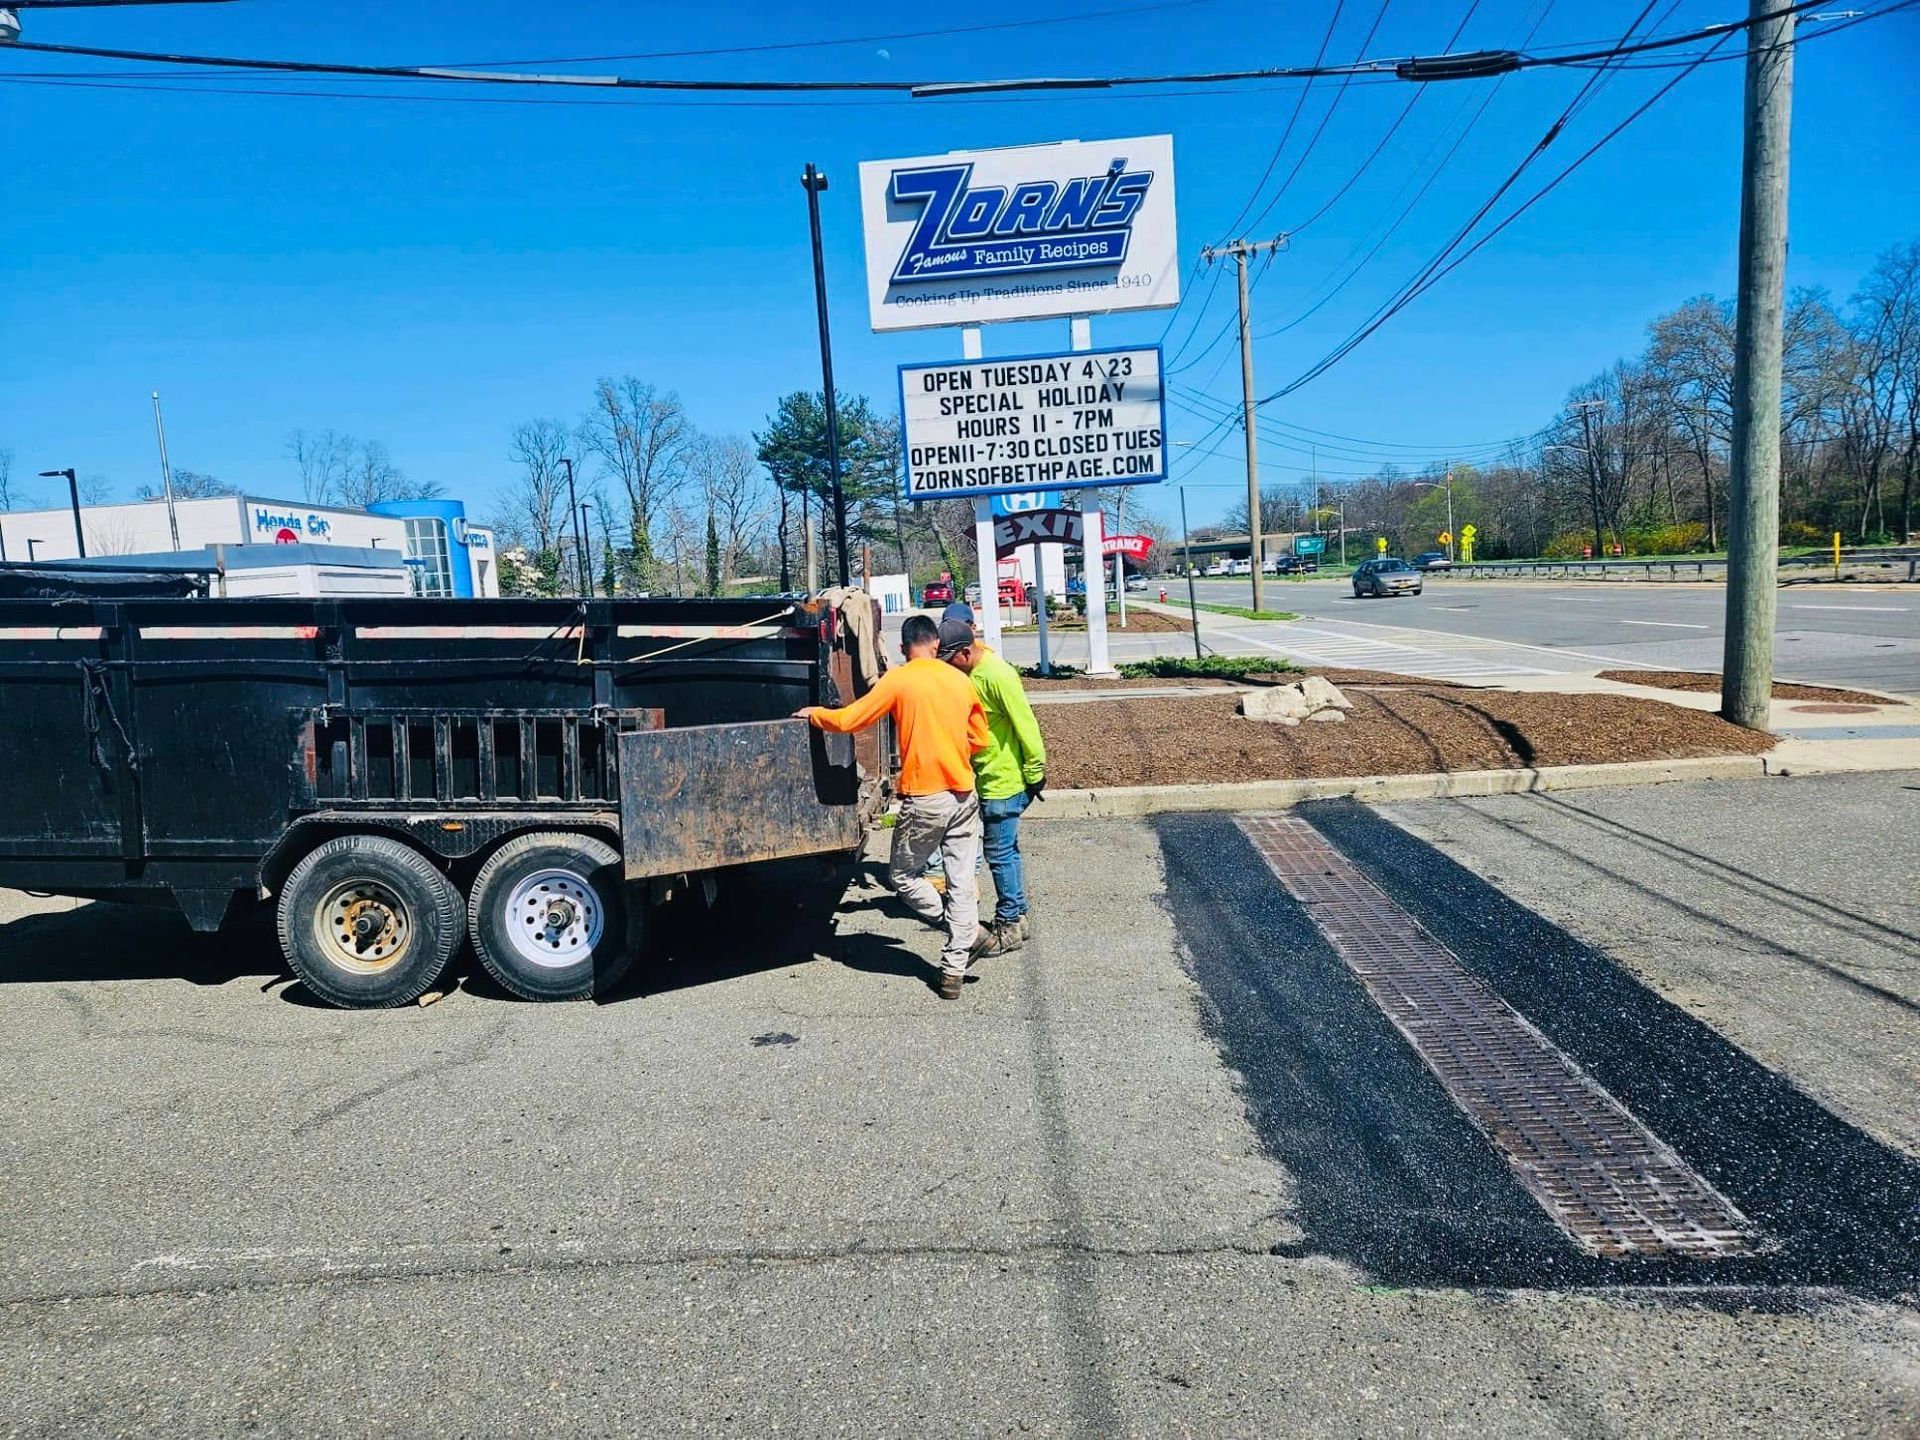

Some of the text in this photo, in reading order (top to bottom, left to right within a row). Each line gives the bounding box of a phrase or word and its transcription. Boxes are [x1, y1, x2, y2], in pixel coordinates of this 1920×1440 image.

[909, 240, 1108, 273] Famous Family Recipes
[895, 273, 1152, 309] Cooking Up Traditions Since 1940
[924, 370, 972, 392] OPEN
[981, 362, 1072, 388] TUESDAY
[940, 382, 1125, 416] SPECIAL HOLIDAY
[957, 416, 1021, 439] HOURS
[1073, 408, 1114, 430] 7PM
[1035, 434, 1109, 458] CLOSED
[1112, 429, 1162, 451] TUES
[914, 454, 1155, 491] ZORNSOFBETHPAGE.COM
[256, 509, 302, 530] Honda
